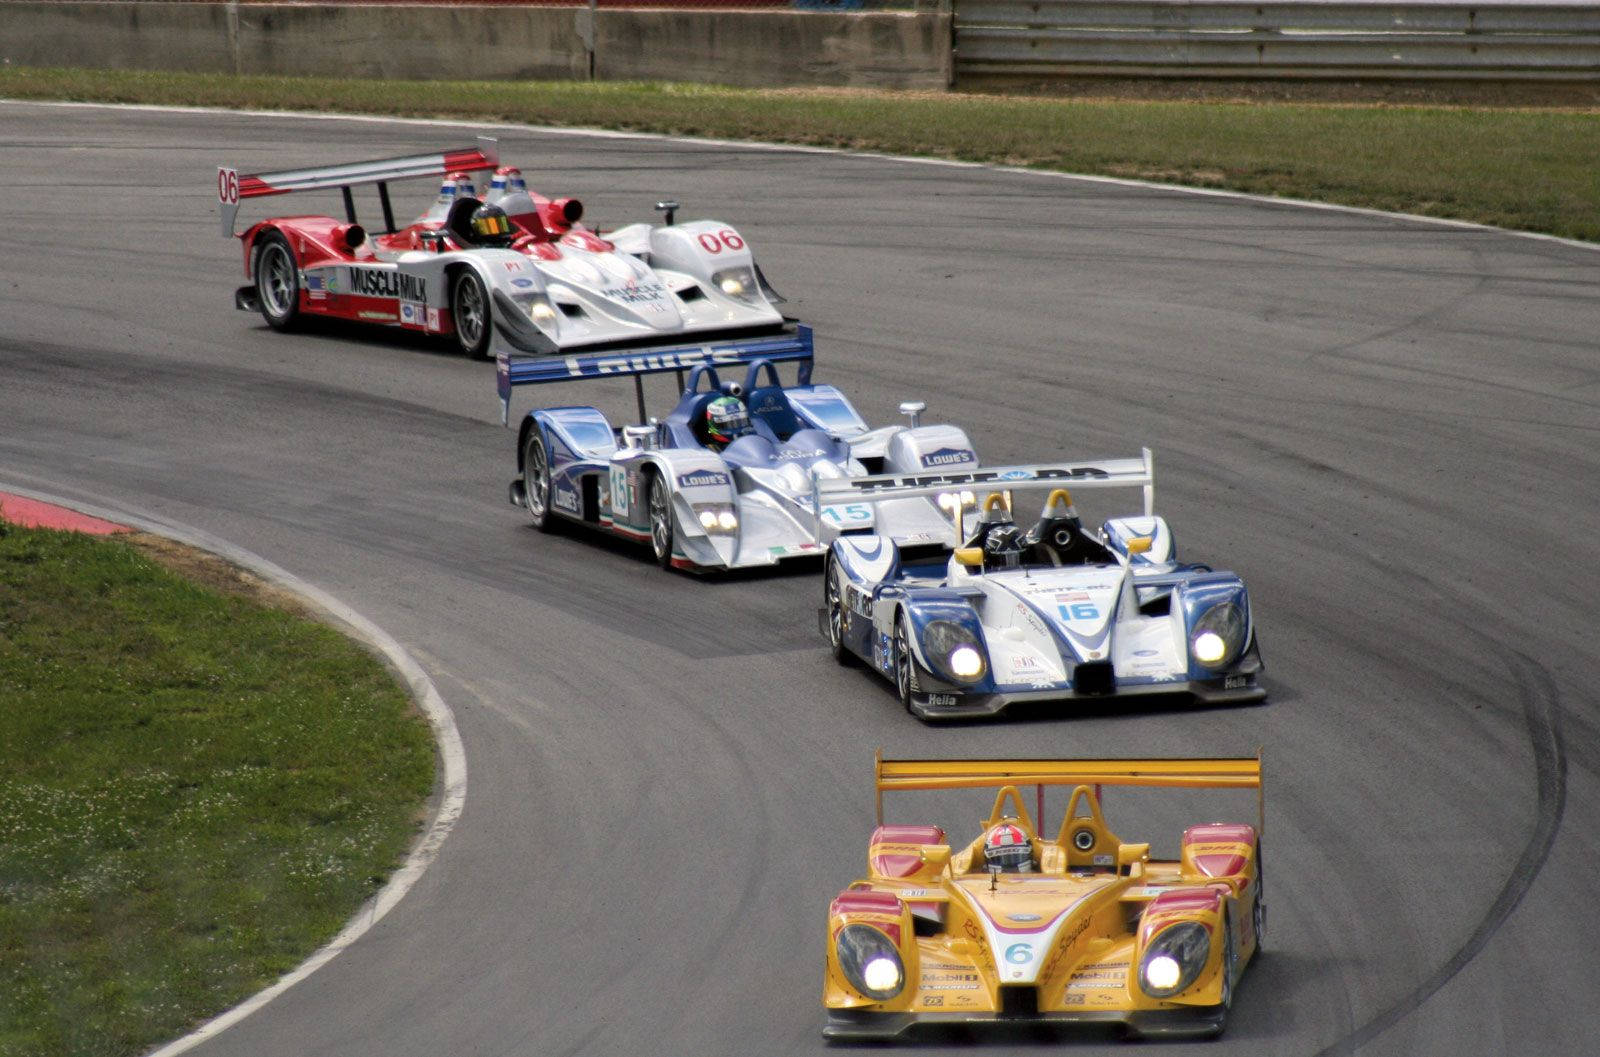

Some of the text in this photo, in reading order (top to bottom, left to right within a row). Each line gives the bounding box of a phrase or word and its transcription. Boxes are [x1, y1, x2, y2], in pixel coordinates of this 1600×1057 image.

[218, 169, 238, 204] 06
[697, 229, 744, 255] 06
[349, 266, 427, 304] MUSCLE MILK
[821, 504, 872, 522] 15
[1057, 603, 1100, 621] 16
[928, 693, 956, 706] Hella
[1004, 942, 1034, 965] 6
